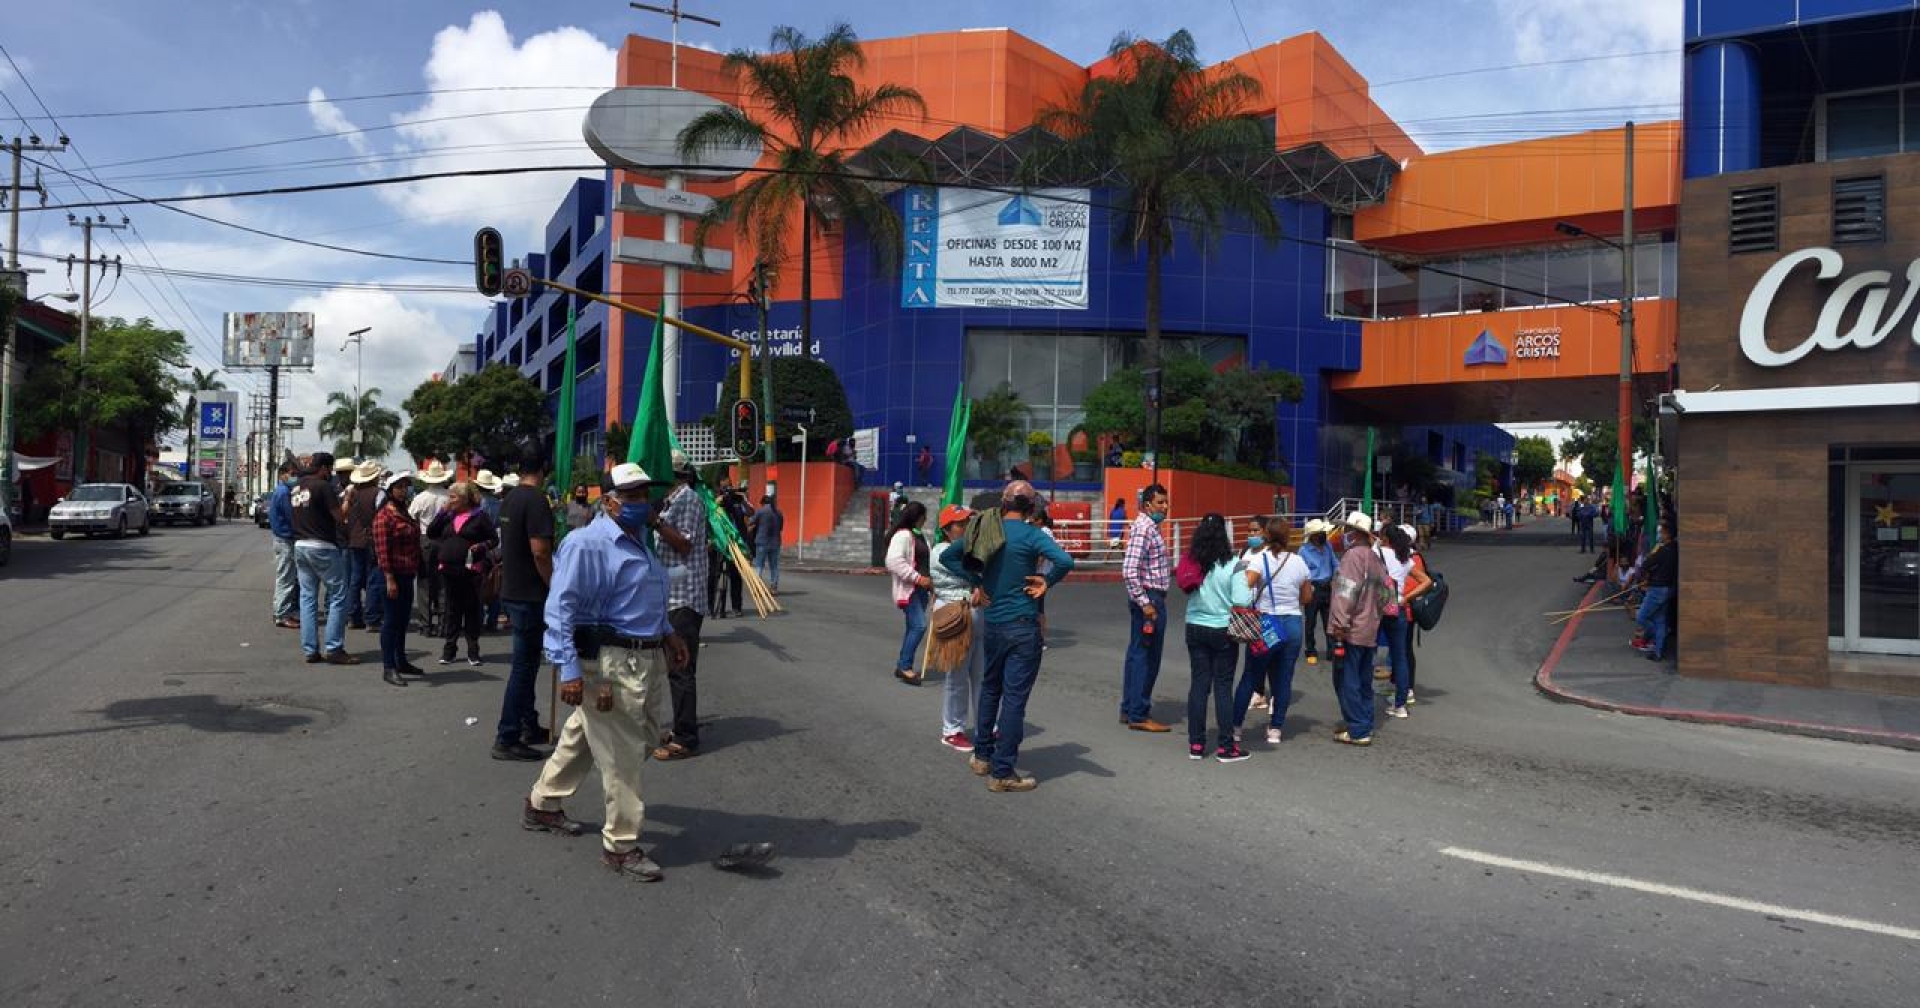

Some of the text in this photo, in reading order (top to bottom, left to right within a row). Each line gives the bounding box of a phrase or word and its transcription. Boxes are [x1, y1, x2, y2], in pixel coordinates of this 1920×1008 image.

[1049, 210, 1087, 220] ARCOS
[1048, 219, 1087, 228] CRISTAL
[908, 194, 934, 303] RENTA
[947, 238, 1082, 251] OFICINAS DESDE 100 M2
[969, 256, 1058, 268] HASTA 8000 M2
[1516, 335, 1561, 347] ARCOS
[1516, 346, 1561, 358] CRISTAL
